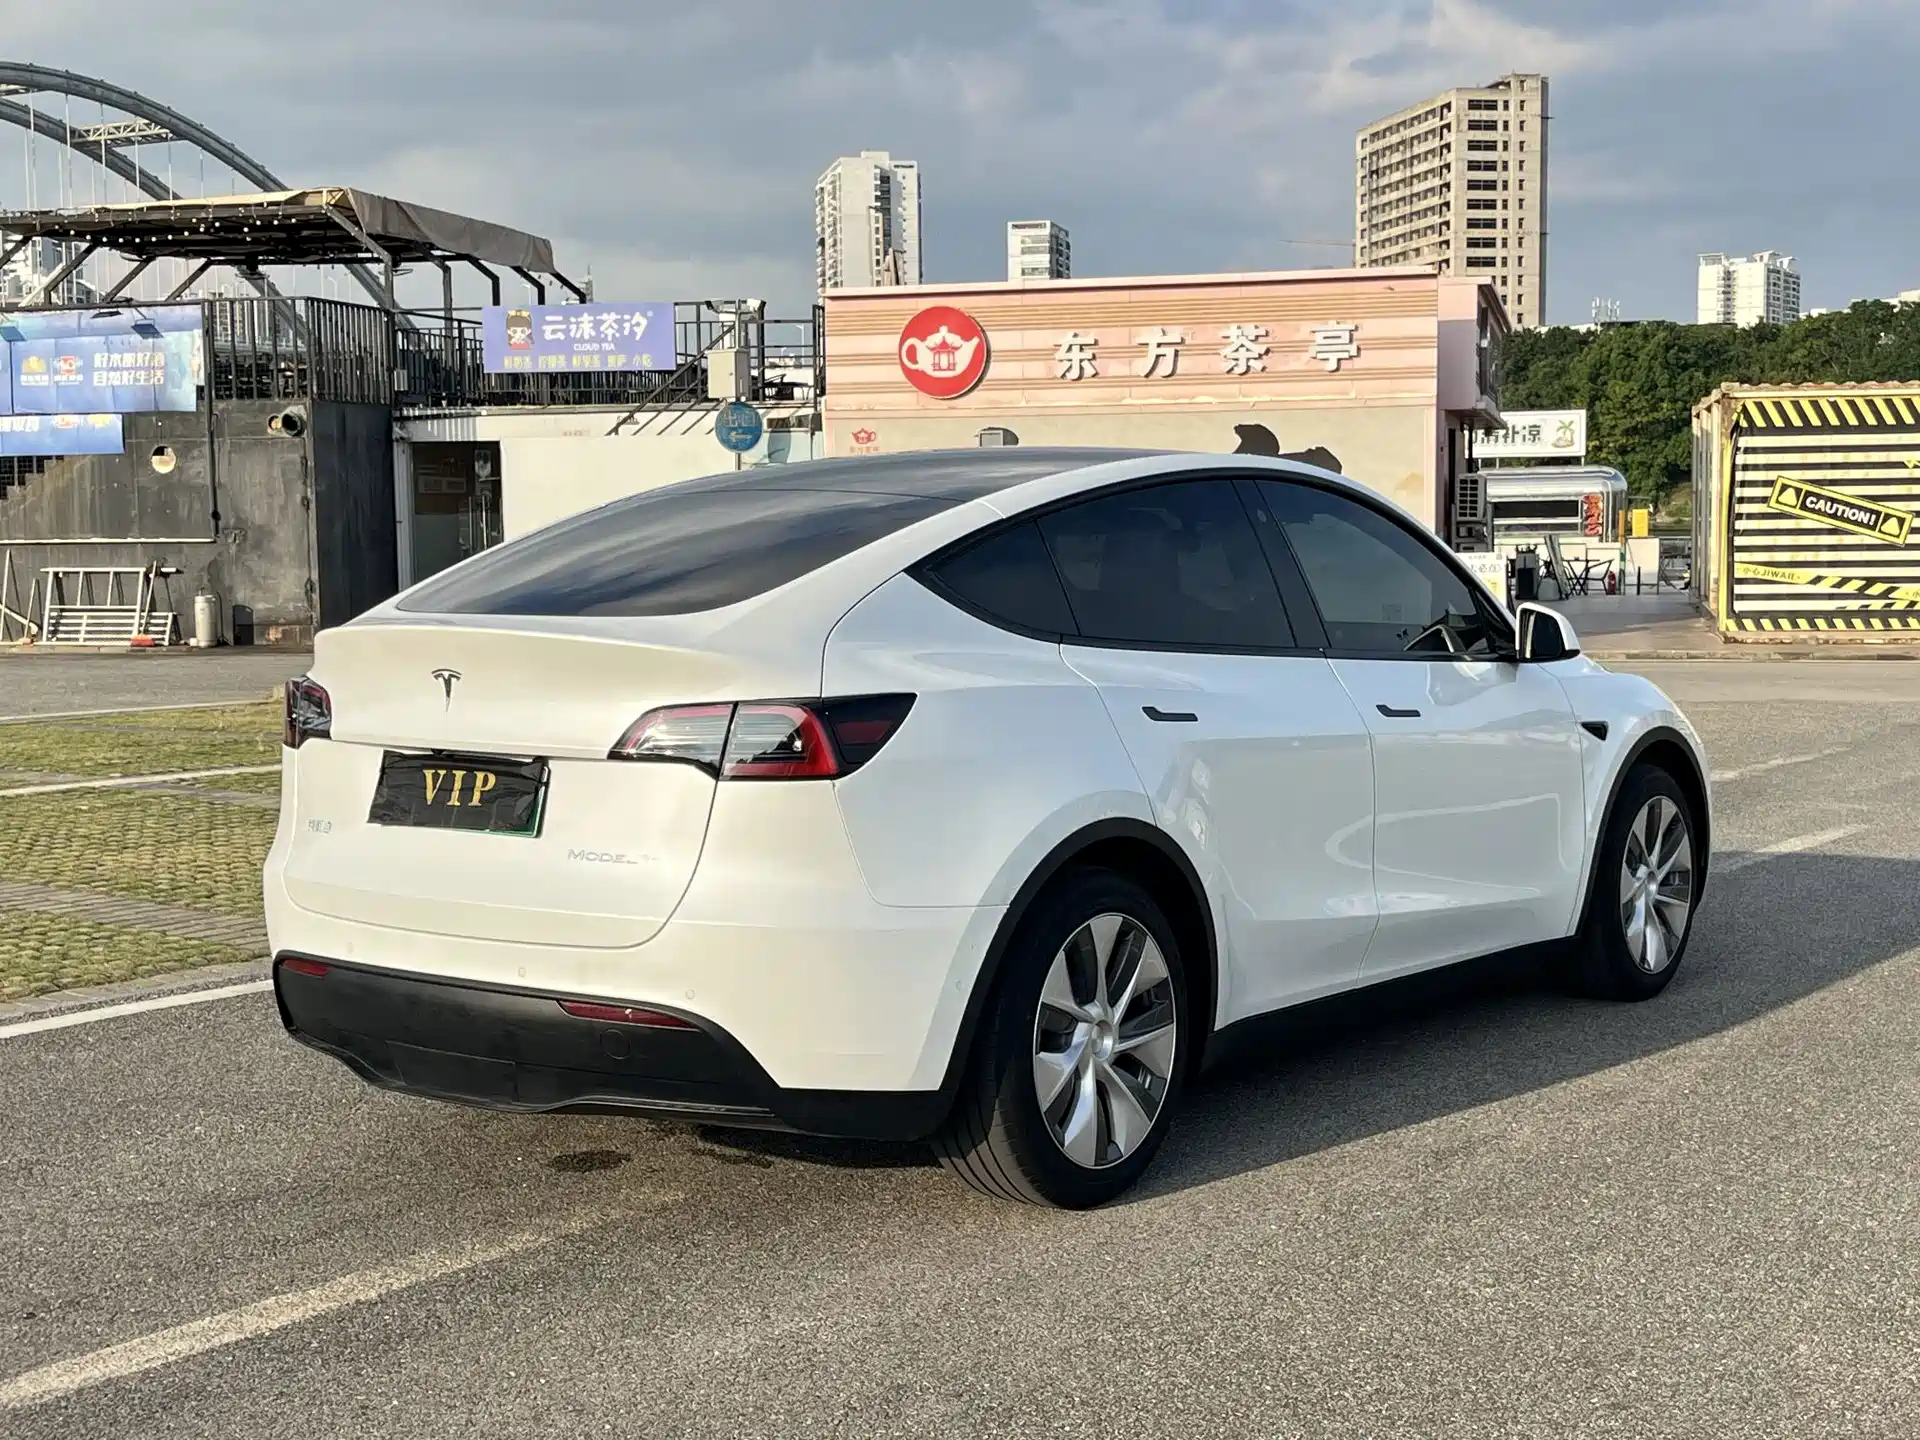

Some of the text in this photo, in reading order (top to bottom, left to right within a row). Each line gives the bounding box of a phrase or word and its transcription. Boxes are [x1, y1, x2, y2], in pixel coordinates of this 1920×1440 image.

[541, 311, 648, 342] 云沫茶汐
[573, 342, 616, 351] CLOUD TEA
[1053, 321, 1360, 381] 东方茶亭
[1805, 496, 1877, 526] CAUTION!
[423, 769, 497, 806] VIP
[568, 848, 638, 864] MODEL
